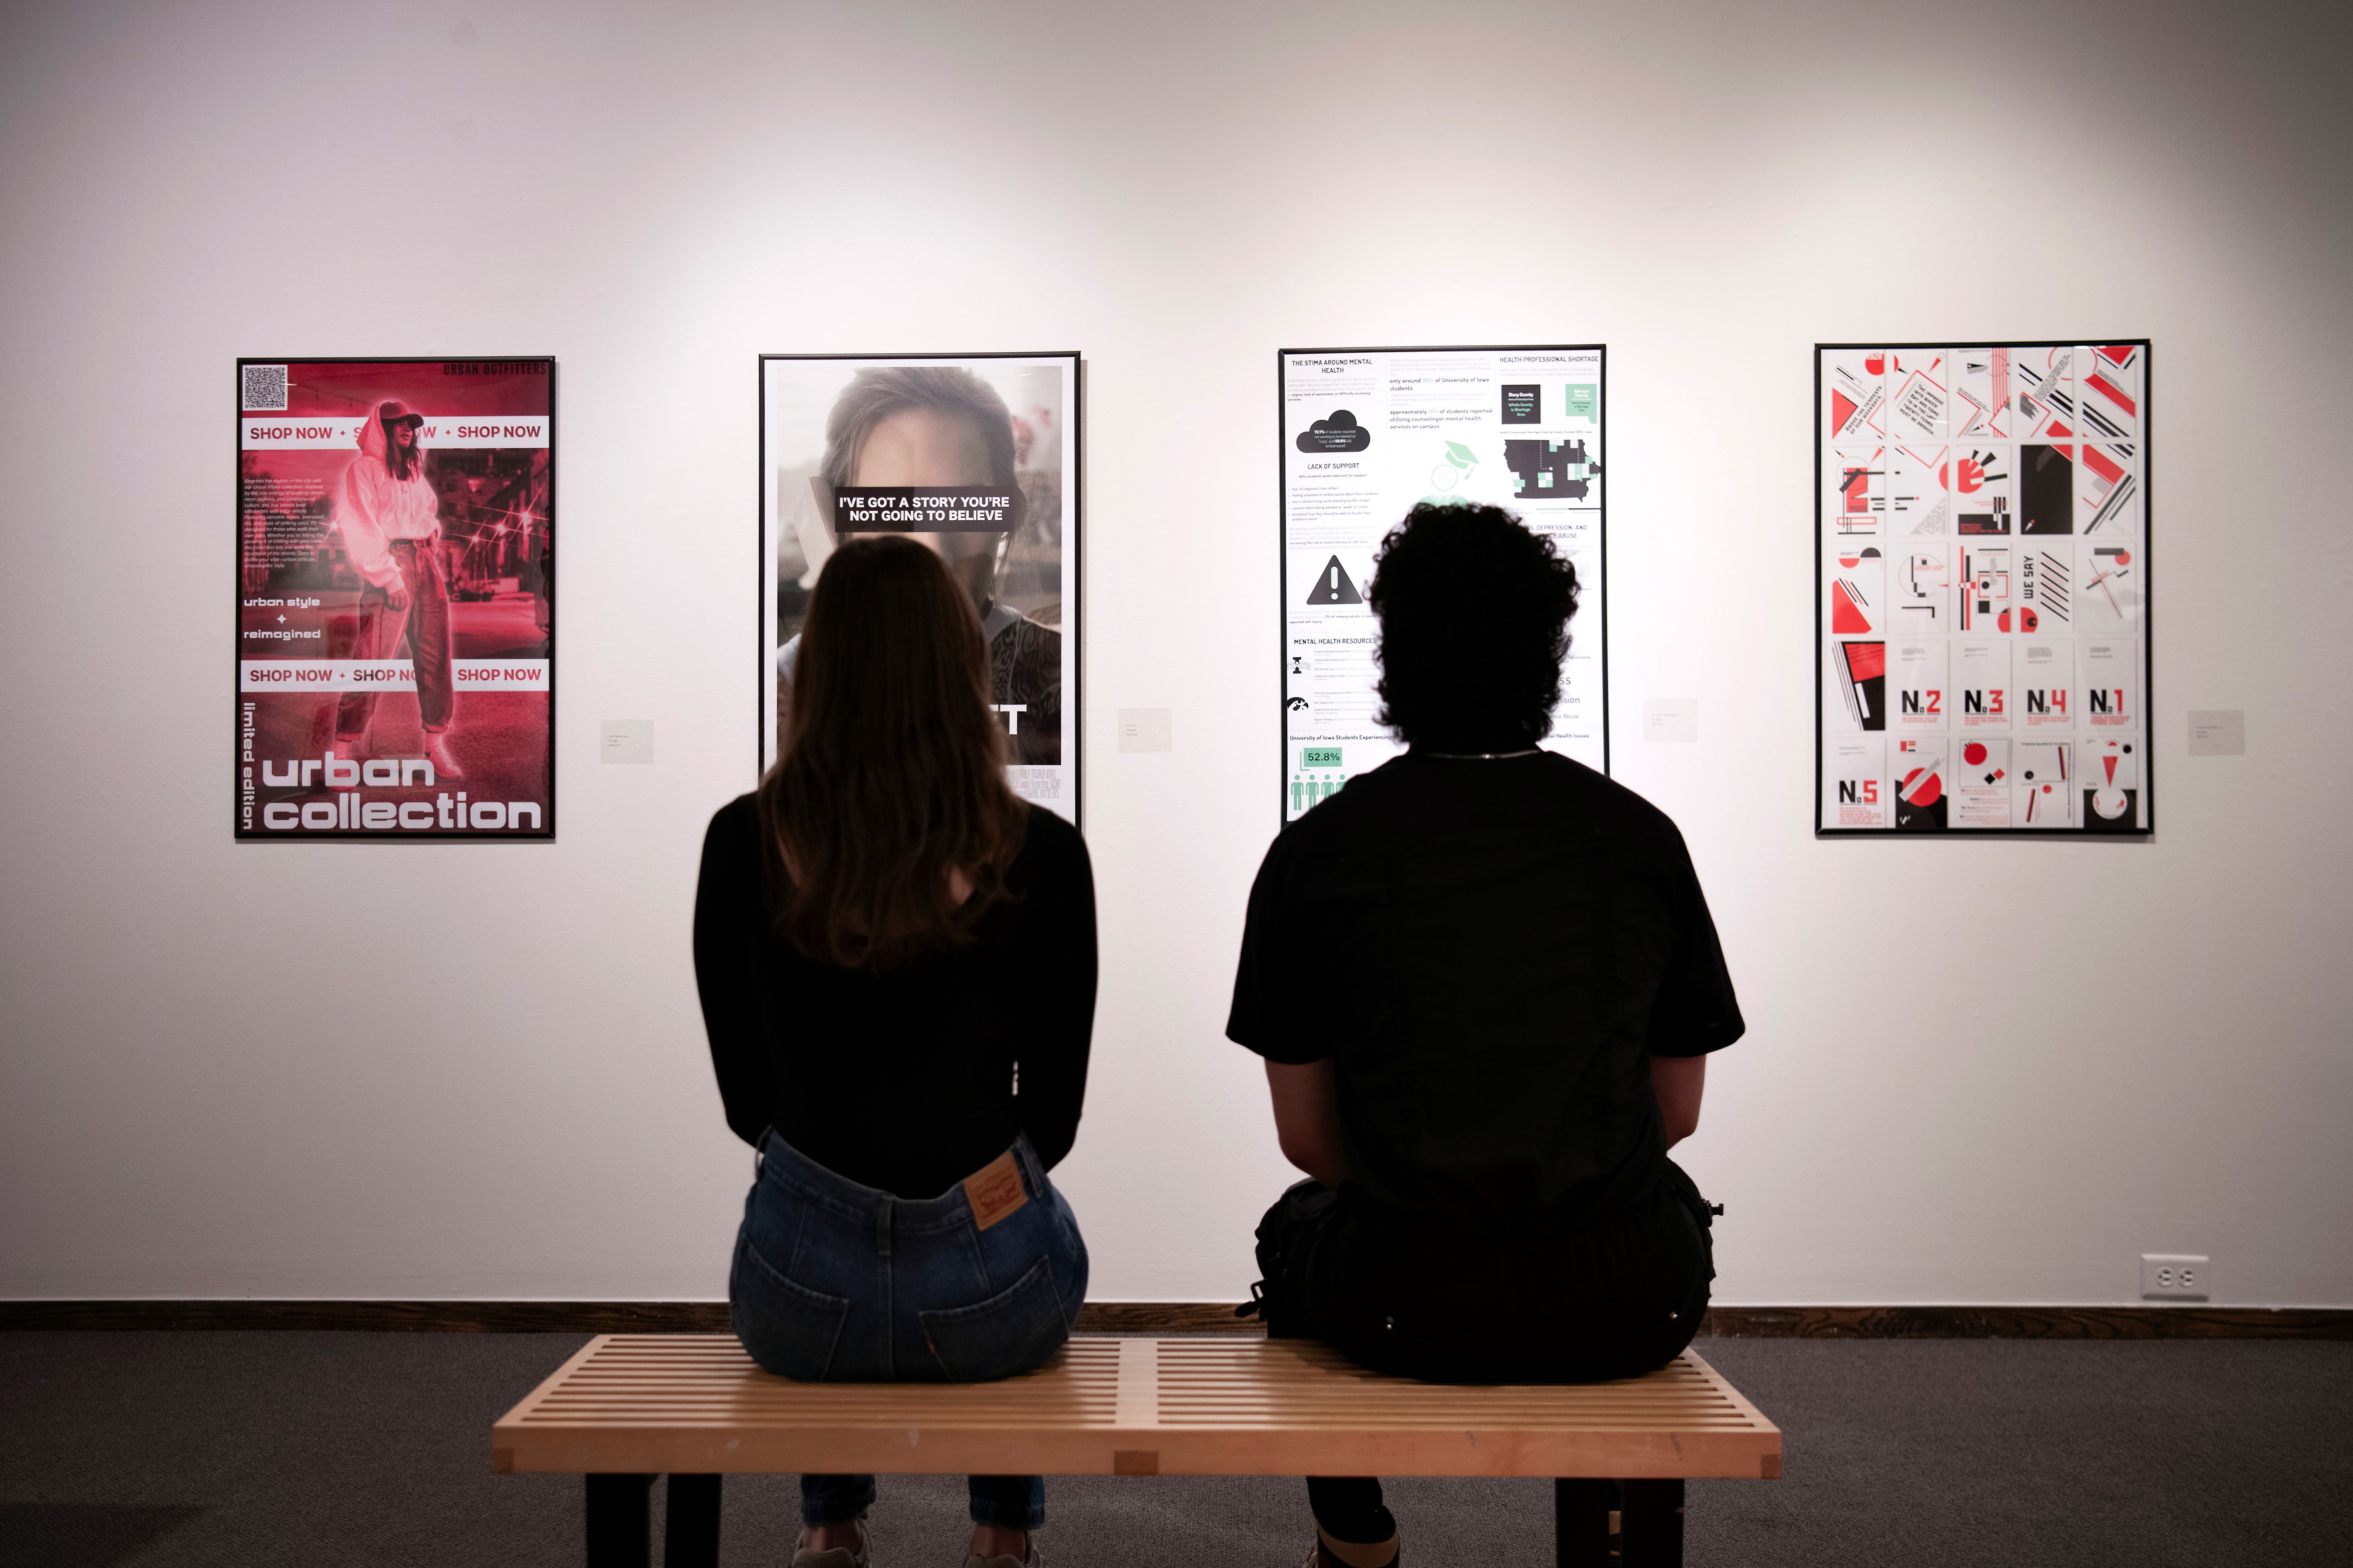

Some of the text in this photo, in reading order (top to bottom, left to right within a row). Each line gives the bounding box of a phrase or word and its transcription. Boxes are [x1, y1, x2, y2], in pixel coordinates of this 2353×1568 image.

[444, 363, 546, 375] URBAN OUTFITTERS
[250, 427, 332, 439] SHOP NOW
[458, 426, 541, 438] SHOP NOW
[868, 497, 896, 508] GOT
[899, 497, 909, 507] A
[912, 497, 956, 507] STORY
[850, 510, 1003, 521] NOT GOING TO BELIEVE
[2023, 556, 2033, 599] WE SAY
[287, 597, 320, 608] style
[244, 629, 320, 640] reimagined
[250, 670, 332, 682] SHOP NOW
[353, 670, 395, 681] SHOP
[458, 669, 541, 680] SHOP NOW
[243, 702, 256, 829] limited edition
[263, 751, 435, 787] urban
[264, 792, 541, 829] collection
